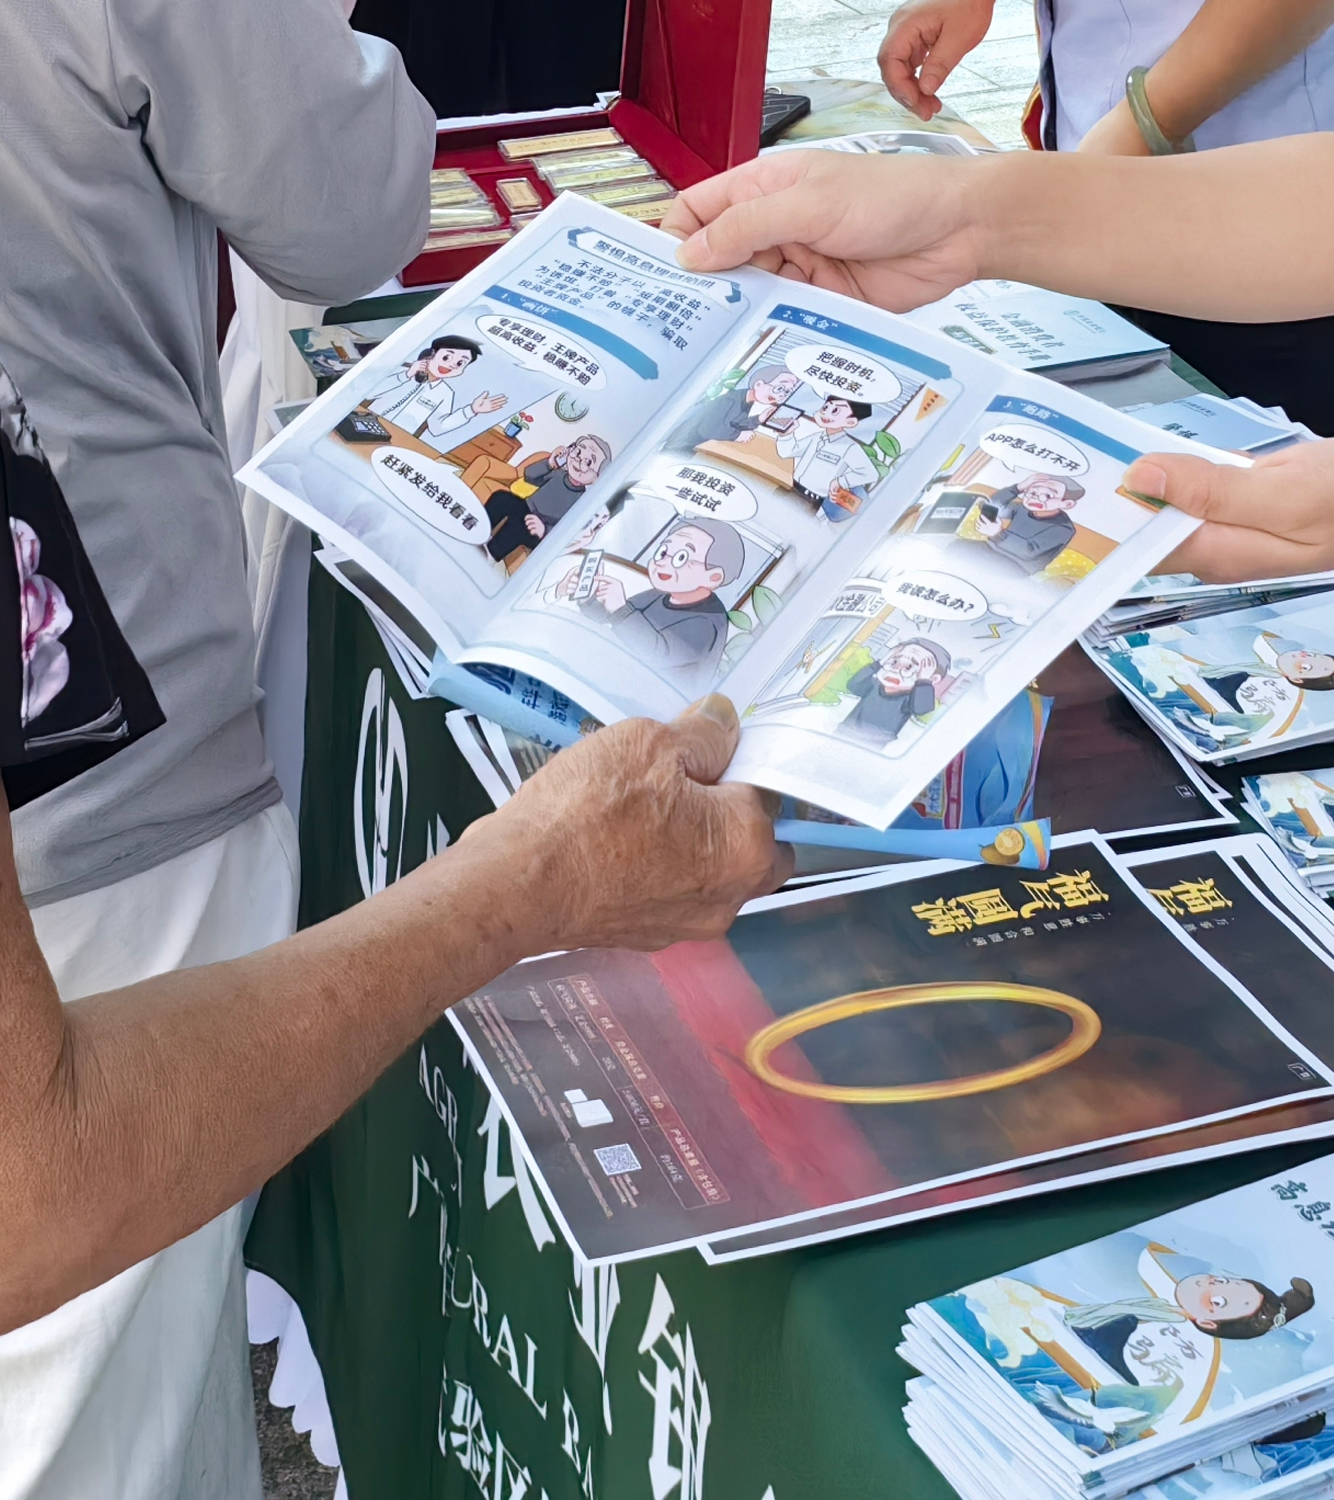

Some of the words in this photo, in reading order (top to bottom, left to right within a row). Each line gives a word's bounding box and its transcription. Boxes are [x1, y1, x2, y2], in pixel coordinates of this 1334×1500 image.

[593, 239, 716, 290] 警惕高息理财陷阱
[498, 317, 601, 377] 专享理财，王牌产品
[983, 432, 1082, 474] APP怎么打不开
[380, 453, 480, 531] 赶紧发给我看看
[665, 483, 723, 513] 一些试试
[675, 466, 737, 497] 那我投资
